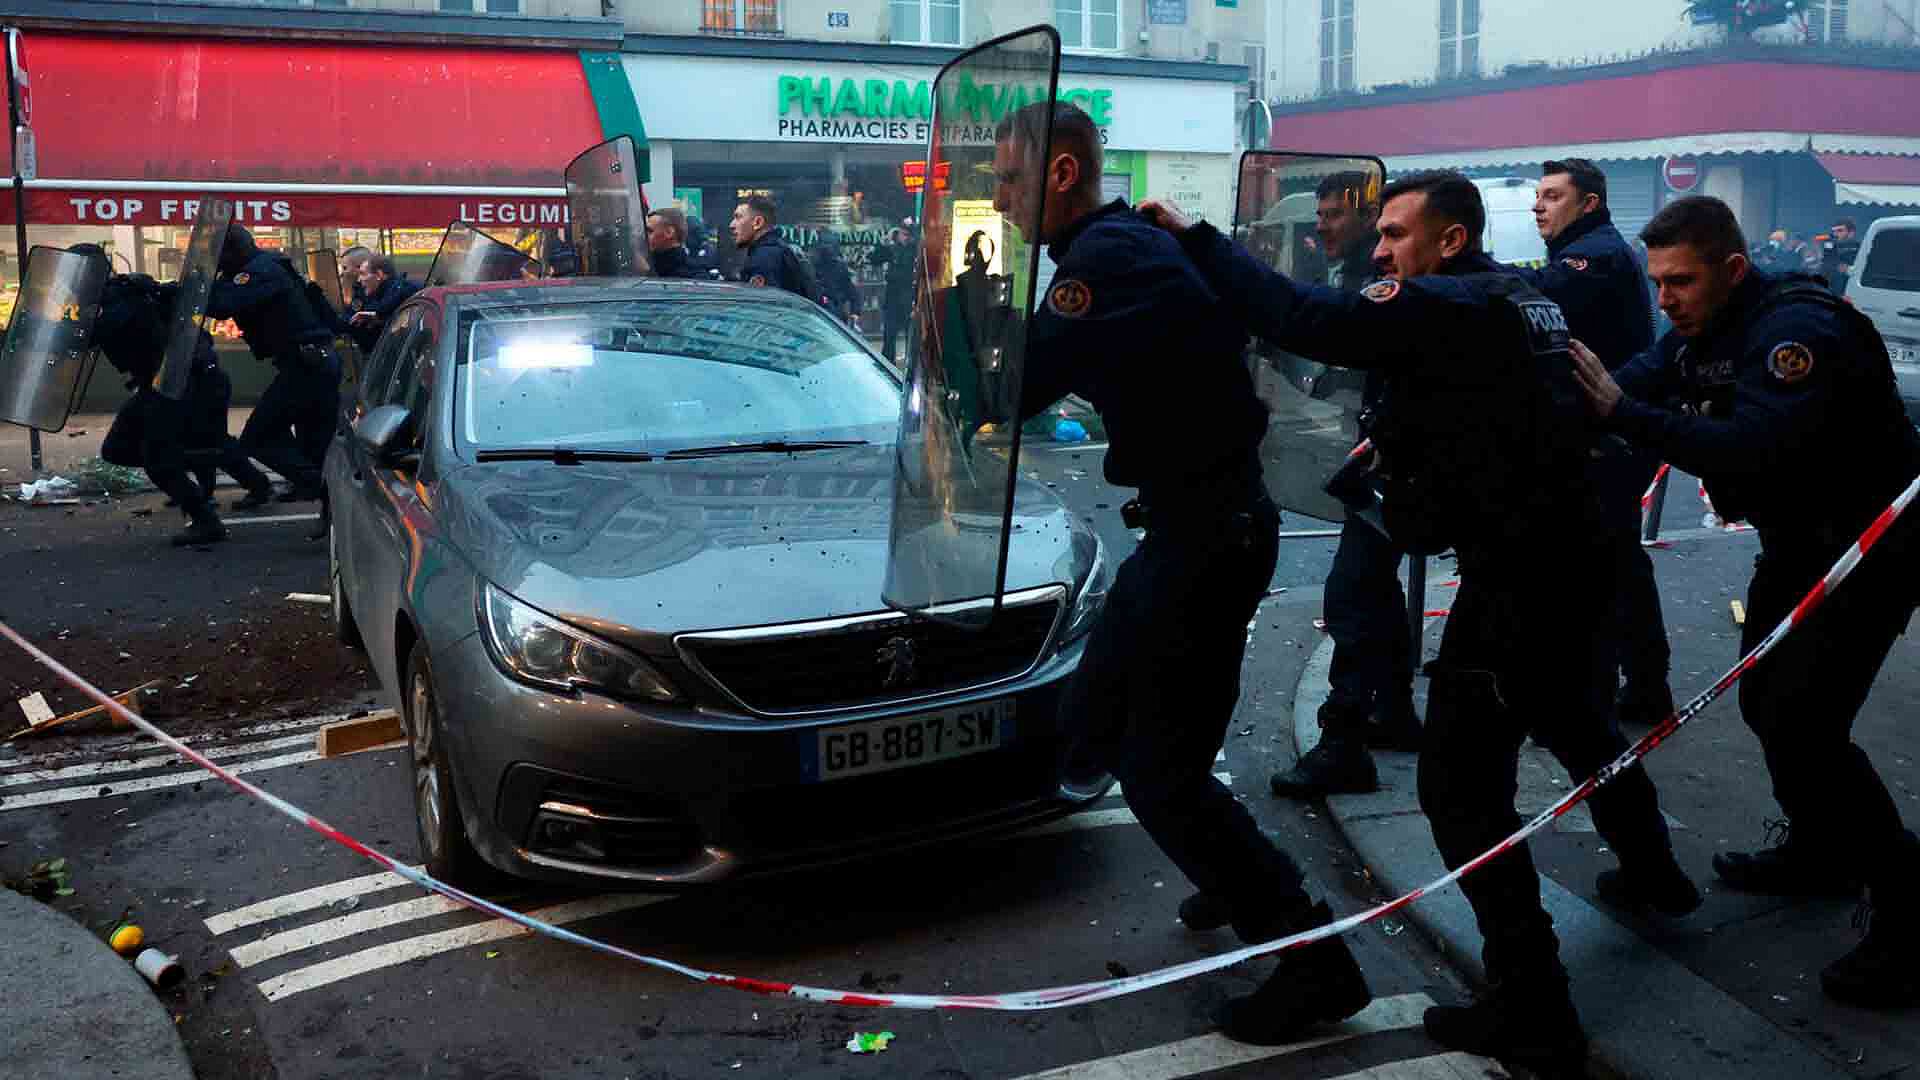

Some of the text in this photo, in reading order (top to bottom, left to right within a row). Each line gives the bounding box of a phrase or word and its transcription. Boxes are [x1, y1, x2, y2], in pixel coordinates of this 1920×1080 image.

[778, 119, 909, 139] PHARMACIES
[70, 199, 293, 221] TOP FRUITS
[826, 708, 996, 771] GB-887-SW
